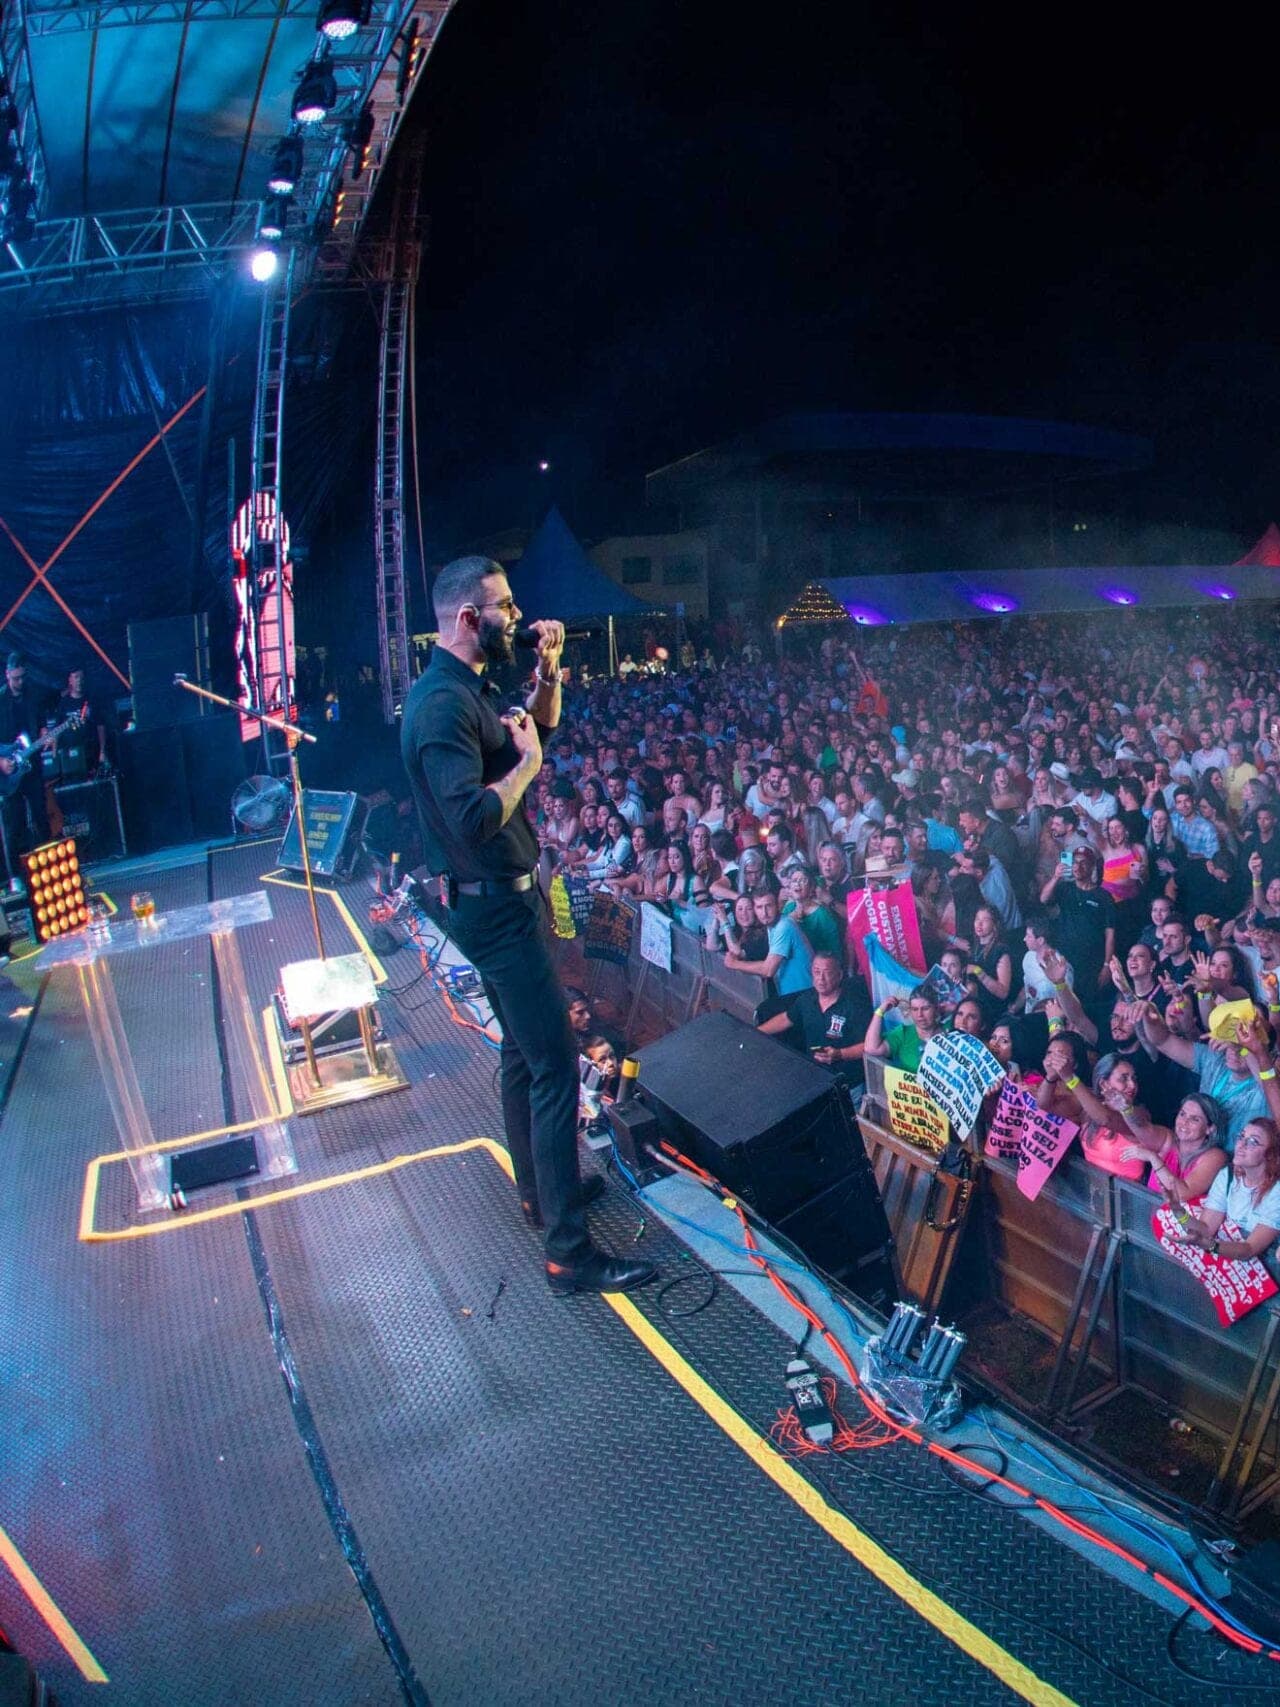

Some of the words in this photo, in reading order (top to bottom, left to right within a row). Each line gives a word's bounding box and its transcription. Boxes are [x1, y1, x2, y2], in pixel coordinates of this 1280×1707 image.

[932, 1035, 973, 1071] SAUDADE
[919, 1065, 954, 1100] MICHELE
[1026, 1110, 1060, 1139] GORA
[1032, 1130, 1059, 1152] SEU
[1020, 1136, 1055, 1169] ALIZA
